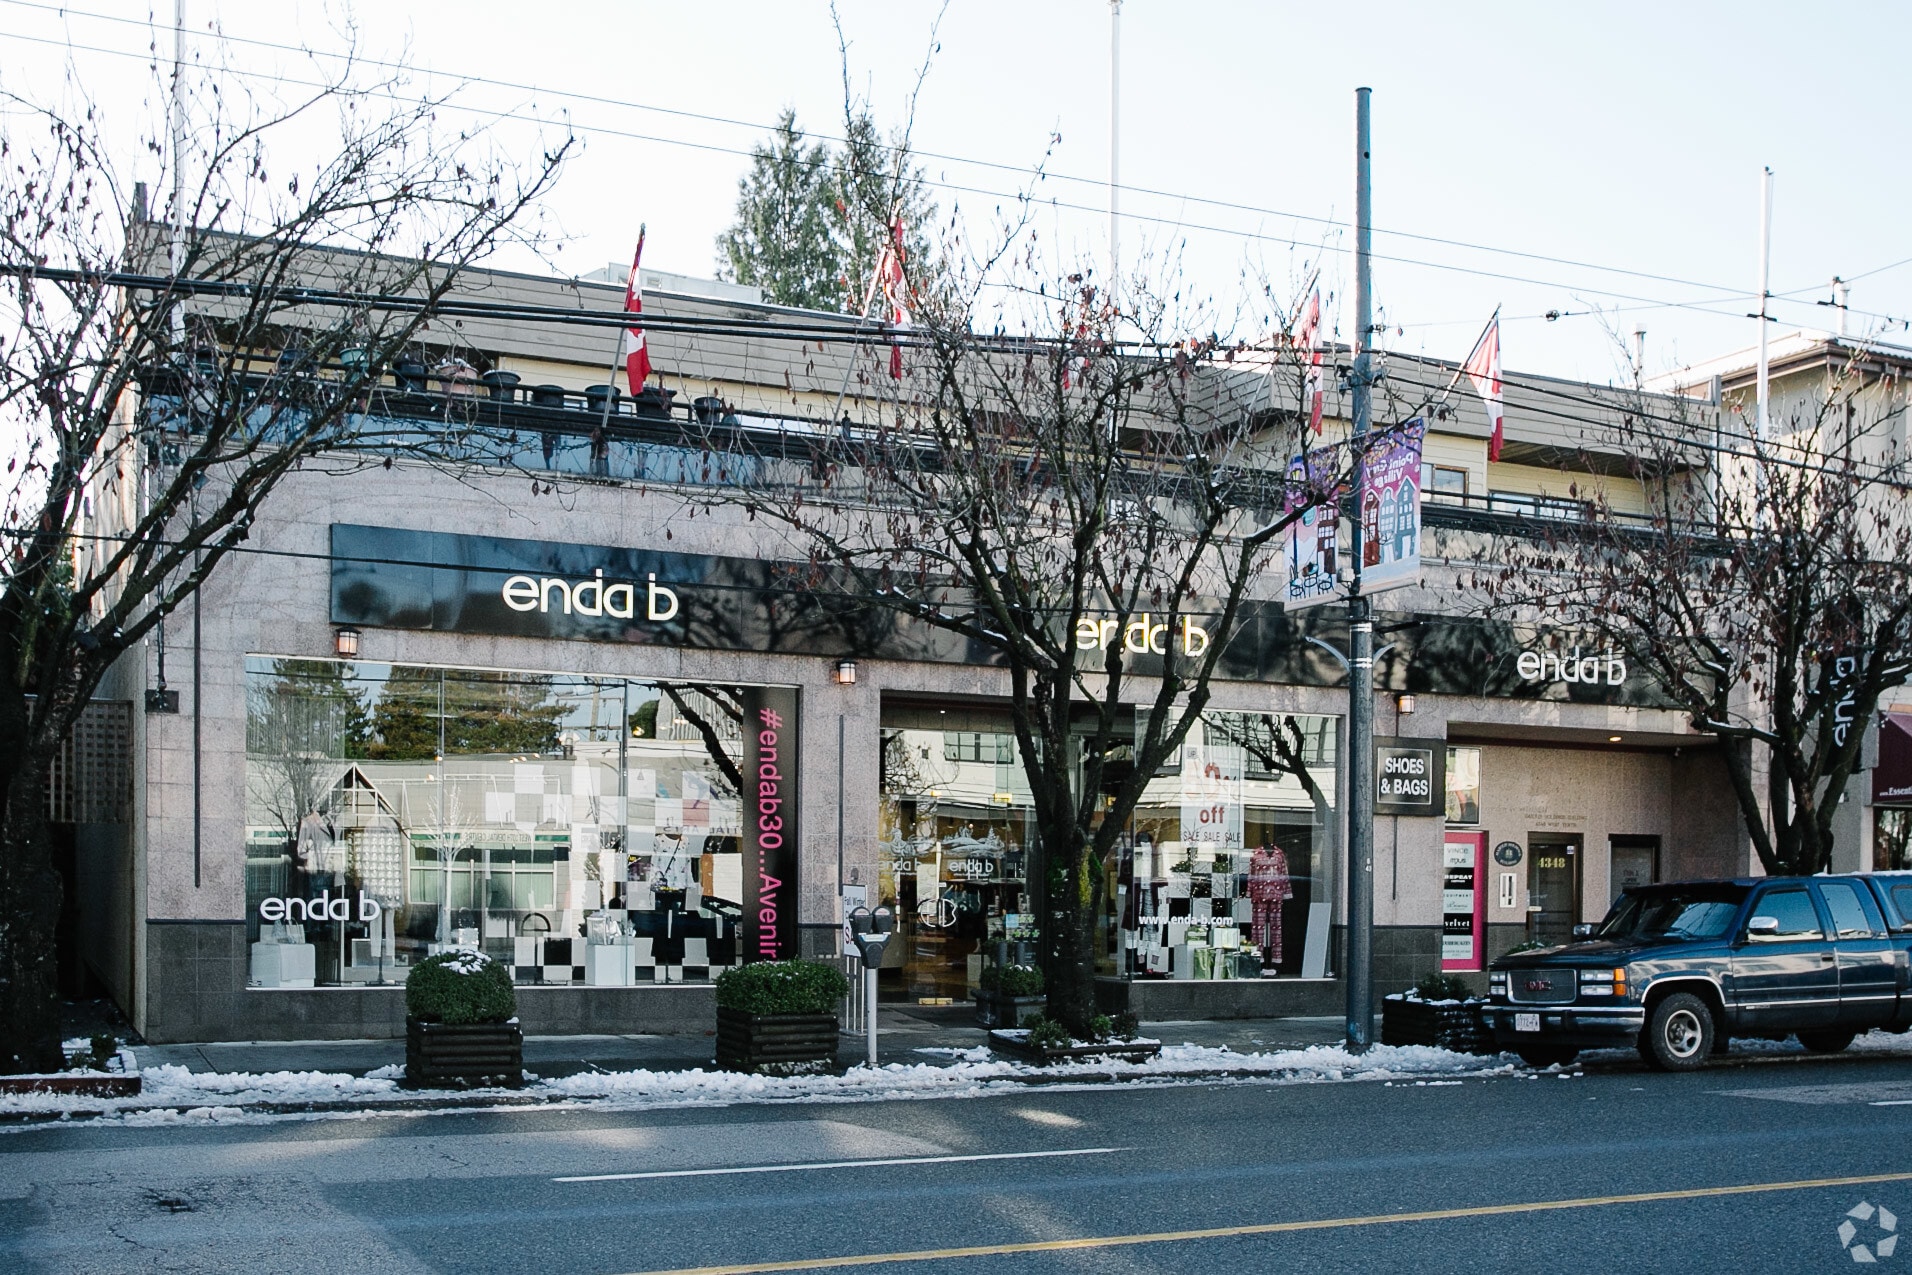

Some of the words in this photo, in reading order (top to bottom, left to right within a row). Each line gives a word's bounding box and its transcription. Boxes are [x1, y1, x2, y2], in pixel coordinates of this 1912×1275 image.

[502, 568, 634, 619] enda
[648, 572, 679, 621] b
[1183, 613, 1210, 657] b
[1516, 645, 1599, 684] enda
[1606, 647, 1627, 686] b
[1385, 757, 1425, 775] SHOES
[1380, 778, 1391, 794] &
[1393, 779, 1429, 796] BAGS
[1199, 805, 1225, 824] off
[1183, 831, 1200, 842] SALE
[1203, 831, 1220, 842] SALE
[1224, 832, 1241, 843] SALE
[949, 858, 983, 873] enda
[985, 859, 994, 873] b
[1537, 857, 1566, 869] 4348
[260, 889, 350, 921] enda
[359, 889, 381, 921] b
[1138, 914, 1234, 925] www.enda-b.com
[1444, 918, 1471, 927] velvet
